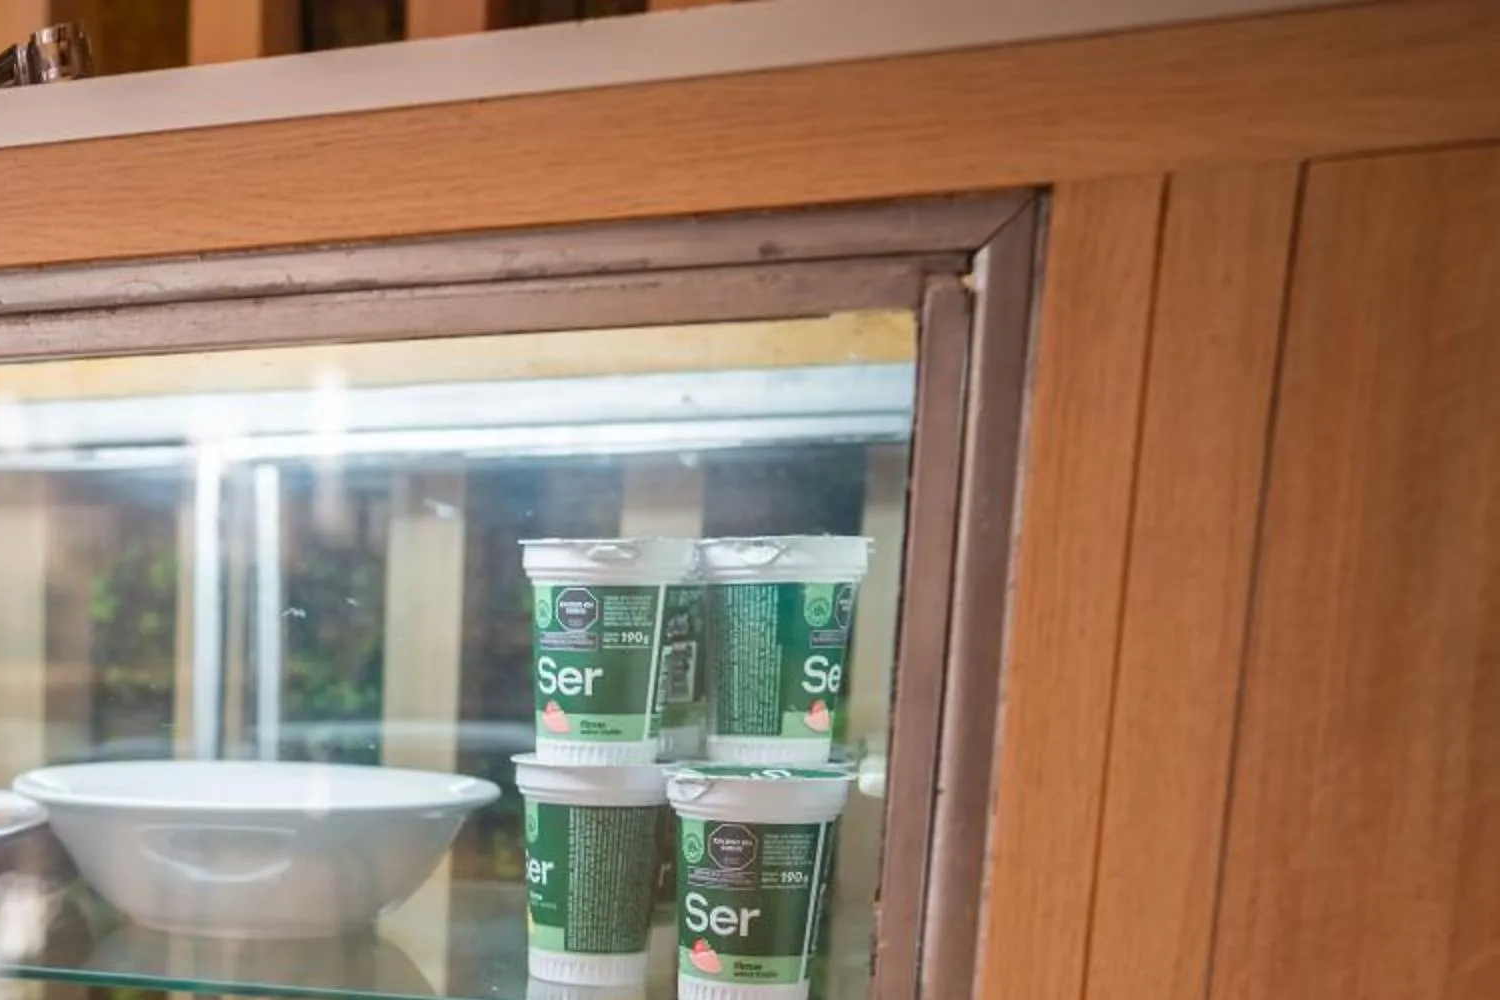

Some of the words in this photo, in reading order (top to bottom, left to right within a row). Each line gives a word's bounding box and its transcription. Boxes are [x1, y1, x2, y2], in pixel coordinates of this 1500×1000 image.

[537, 655, 603, 697] Ser
[801, 654, 842, 694] Se
[525, 848, 555, 885] er
[684, 891, 761, 937] Ser
